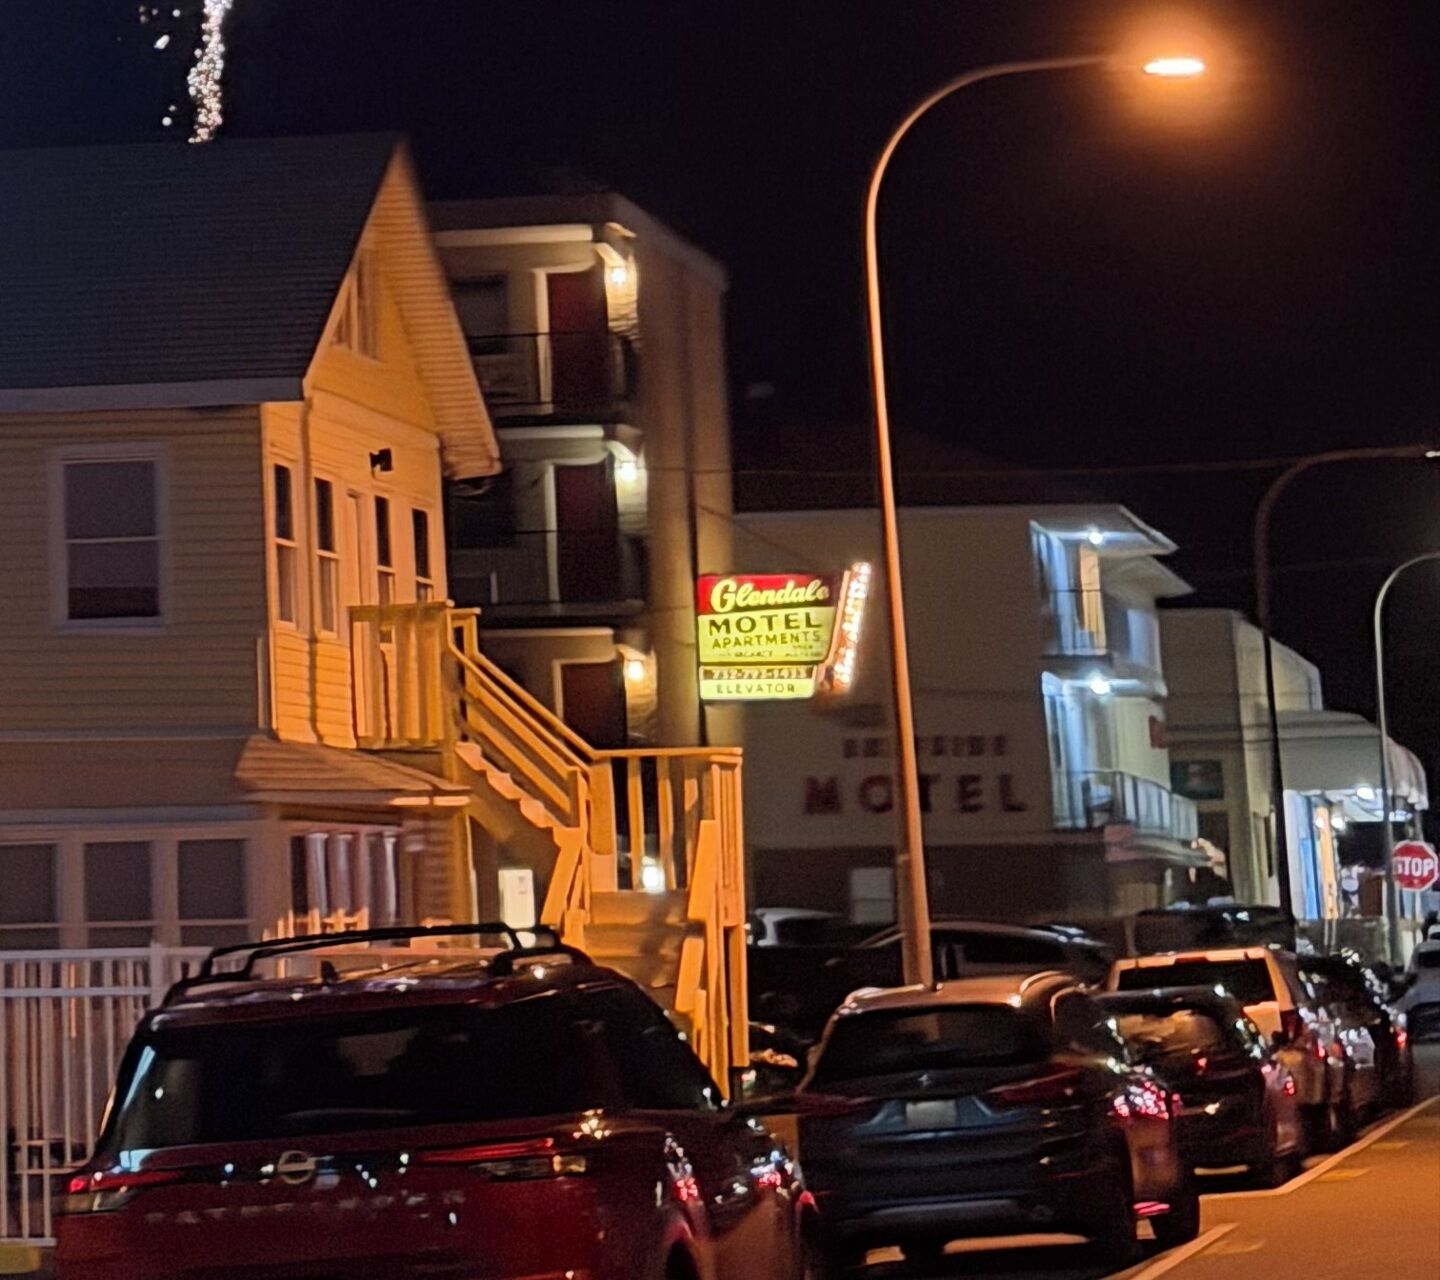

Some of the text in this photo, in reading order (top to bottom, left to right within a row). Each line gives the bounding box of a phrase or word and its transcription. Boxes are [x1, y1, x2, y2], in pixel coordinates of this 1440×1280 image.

[710, 578, 830, 612] Glendale
[708, 611, 823, 636] MOTEL
[712, 630, 821, 649] APARTMENTS
[716, 683, 795, 694] ELEVATOR
[804, 773, 1029, 815] MOTEL
[1394, 856, 1435, 877] STOP
